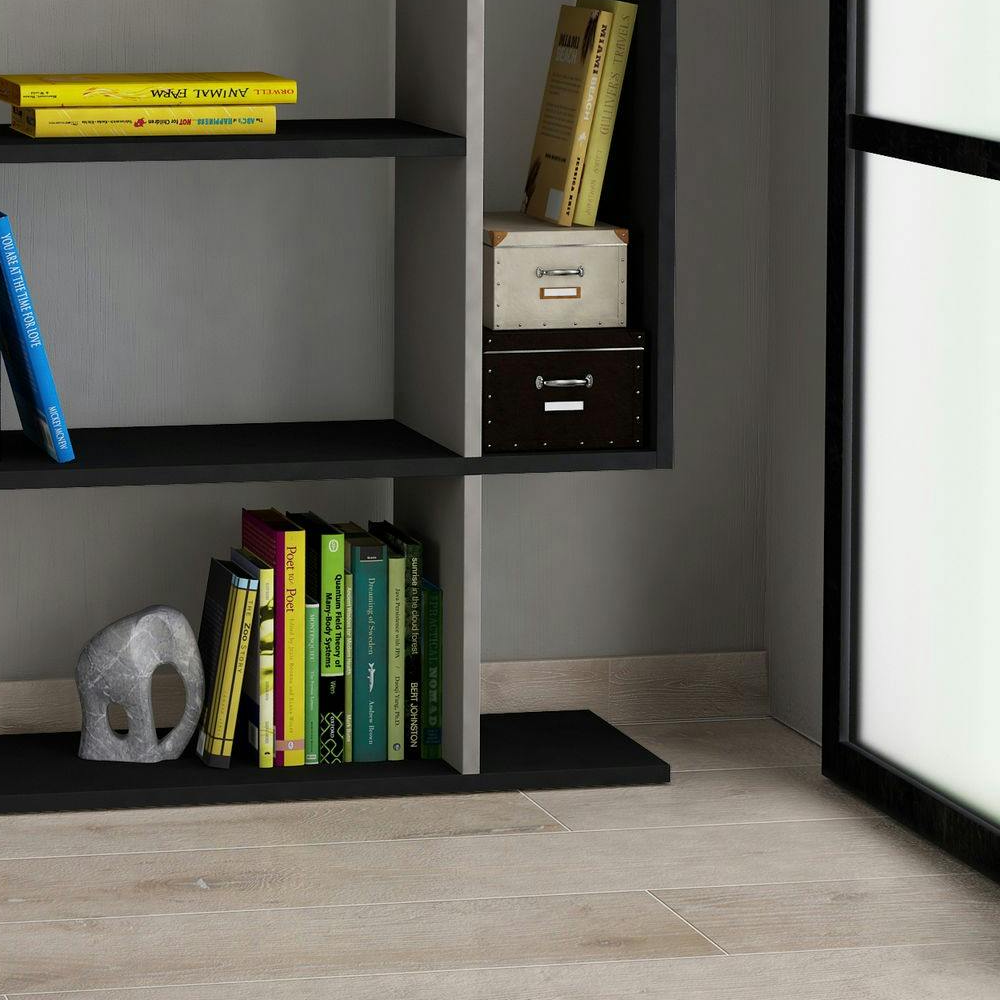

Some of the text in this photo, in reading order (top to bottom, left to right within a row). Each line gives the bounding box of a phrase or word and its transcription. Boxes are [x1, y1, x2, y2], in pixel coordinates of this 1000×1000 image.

[558, 33, 580, 50] MIAMI
[592, 24, 608, 74] MIAMI
[613, 14, 631, 65] TRAVELS
[151, 87, 295, 98] ORWELL ANIMAL FARM
[148, 118, 171, 126] Children
[178, 118, 192, 126] NOT
[0, 232, 42, 348] YOU ARE AT THE TIME FOR LOVE
[47, 405, 61, 429] MICKEY
[286, 546, 297, 571] Poet
[286, 588, 297, 613] Poet
[334, 574, 343, 610] Quantum
[411, 556, 419, 655] sunrise in the cloud forest
[237, 599, 254, 675] THE ZOO STORY
[324, 592, 332, 668] Many-Body Systems
[366, 577, 376, 655] Dreaming of Sweden
[428, 600, 439, 666] PRACTICAL
[333, 631, 342, 658] Theory
[335, 659, 342, 668] of
[410, 682, 419, 748] BERT JOHNSTON
[428, 666, 439, 727] NOMAD
[367, 699, 375, 745] Andrew Brown
